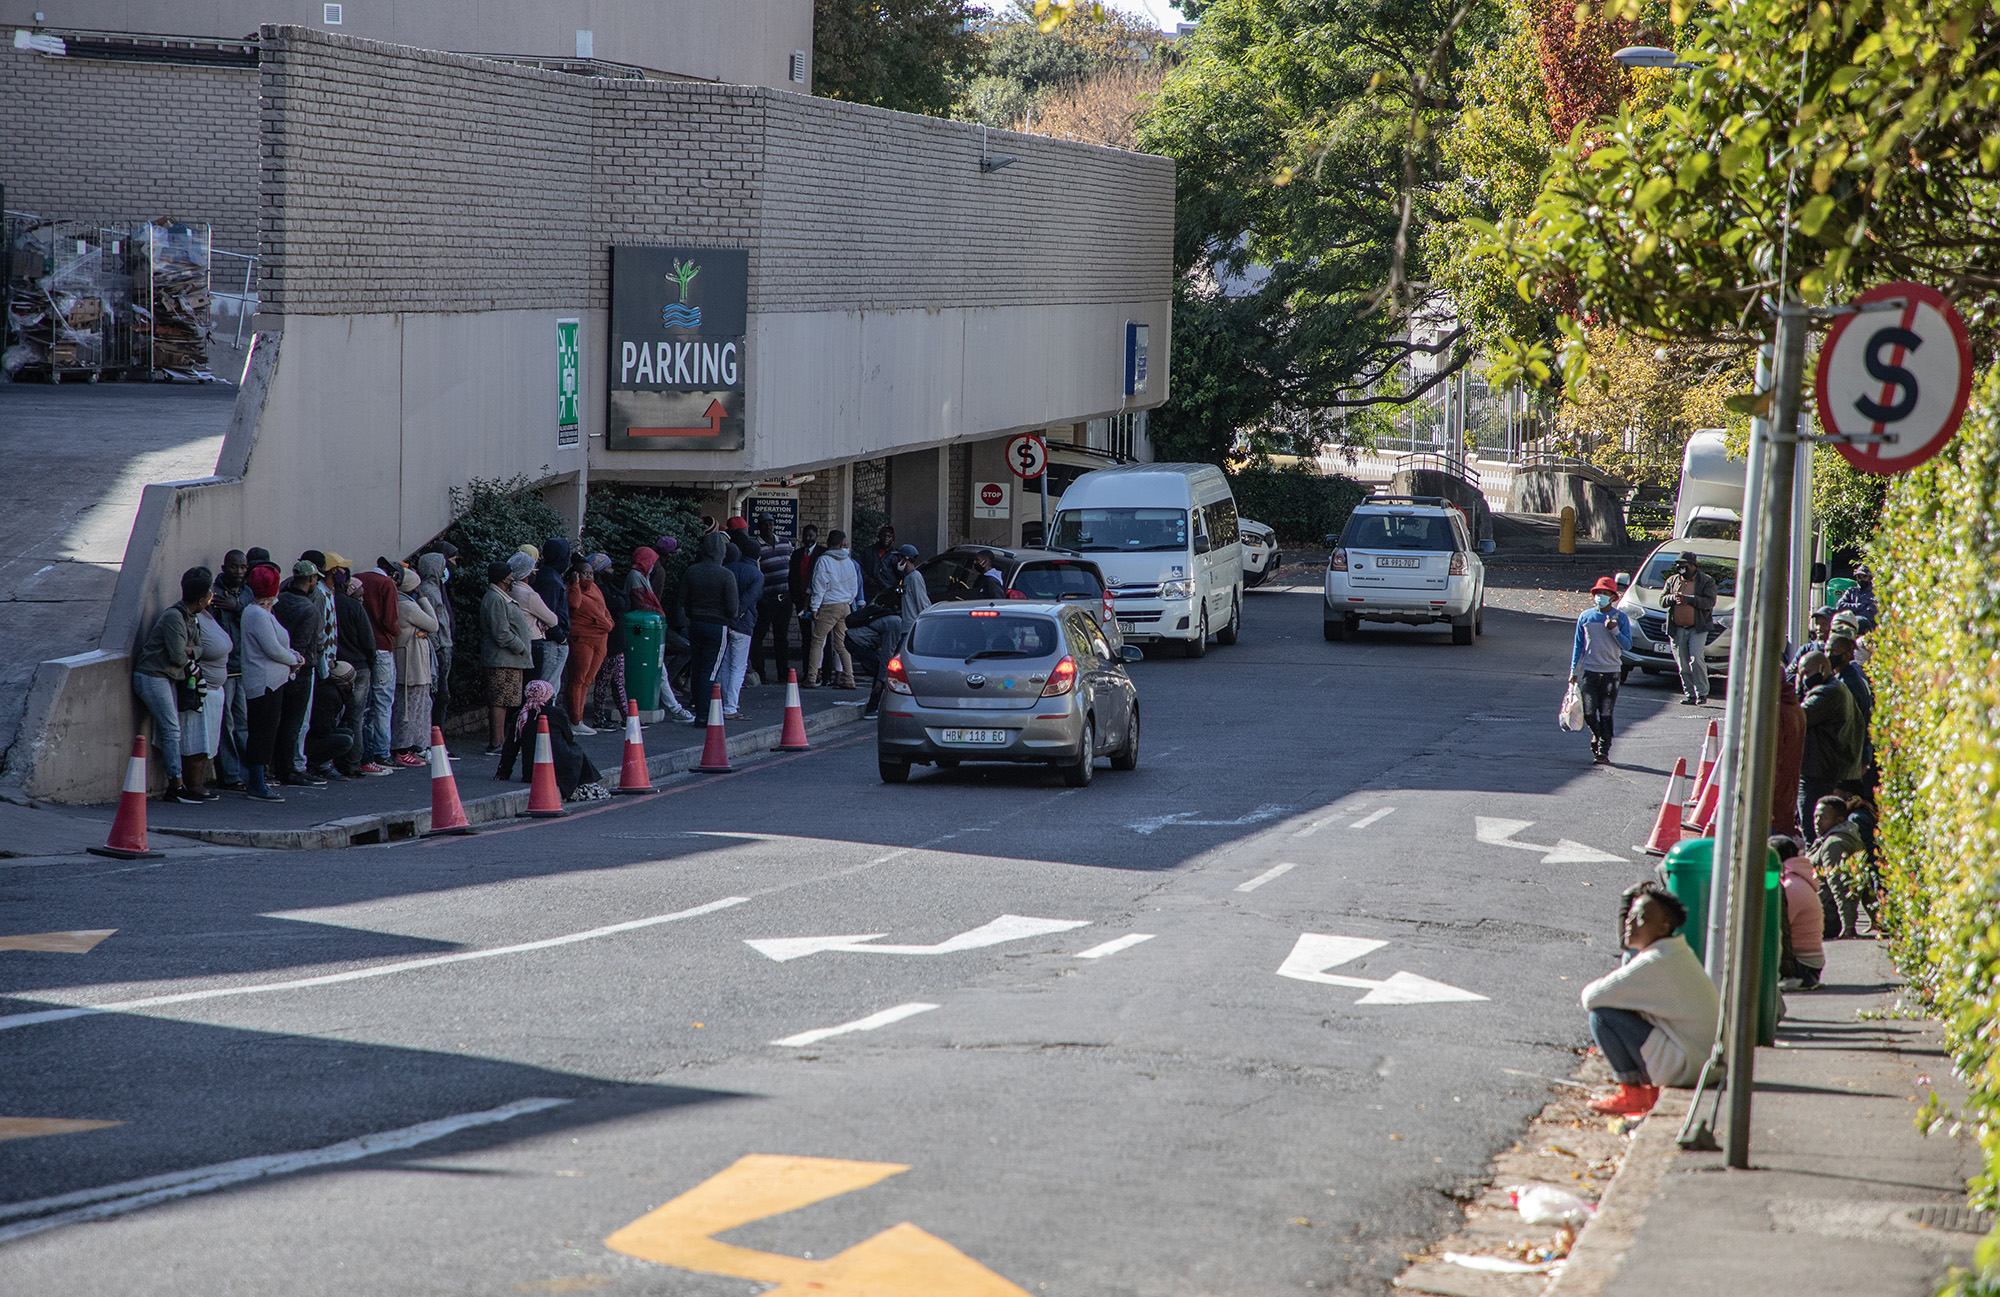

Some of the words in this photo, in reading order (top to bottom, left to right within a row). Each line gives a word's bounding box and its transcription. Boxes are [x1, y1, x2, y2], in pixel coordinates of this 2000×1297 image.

[621, 341, 737, 385] PARKING
[1854, 326, 1923, 423] S
[1017, 444, 1036, 468] S
[946, 730, 962, 740] HBW
[969, 730, 986, 741] 118
[992, 731, 1004, 741] EC
